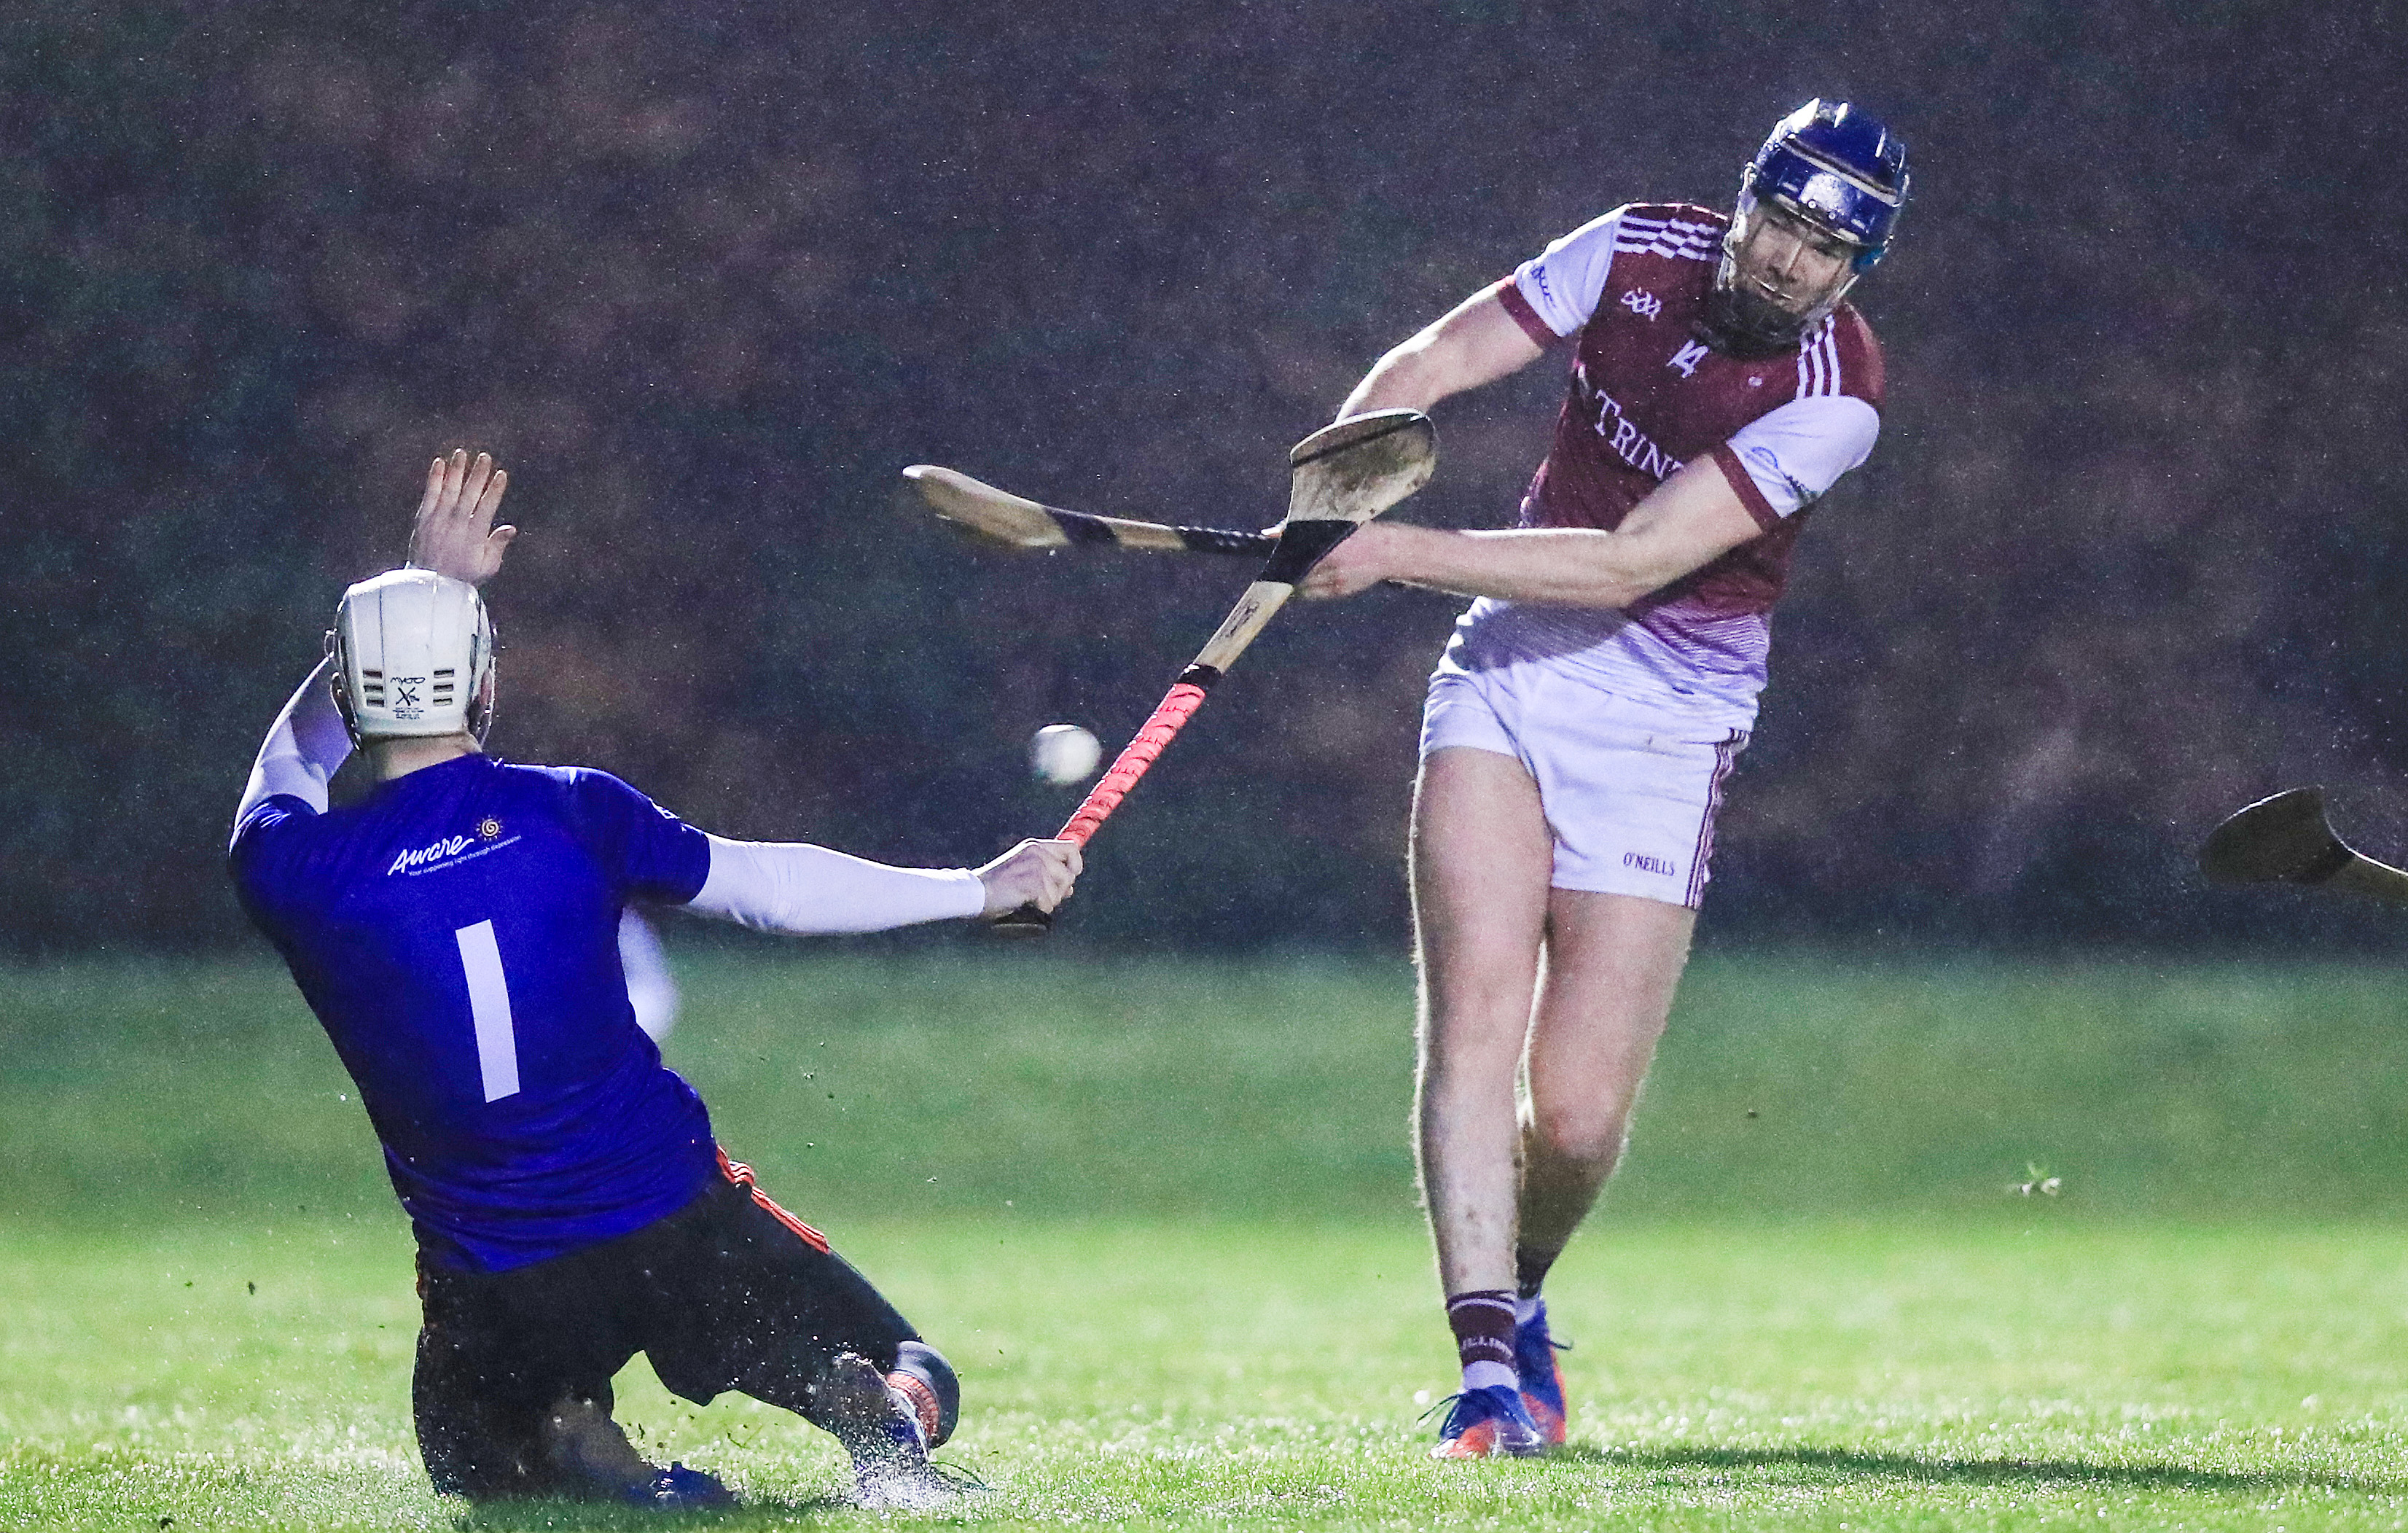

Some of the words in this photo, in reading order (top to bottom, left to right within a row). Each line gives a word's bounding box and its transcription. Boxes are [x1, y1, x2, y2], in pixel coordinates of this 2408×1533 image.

[1666, 339, 1710, 379] 14
[1594, 388, 1684, 481] TRIN
[387, 835, 474, 875] Aware
[1623, 852, 1674, 876] O'NEILLS
[455, 918, 520, 1104] 1
